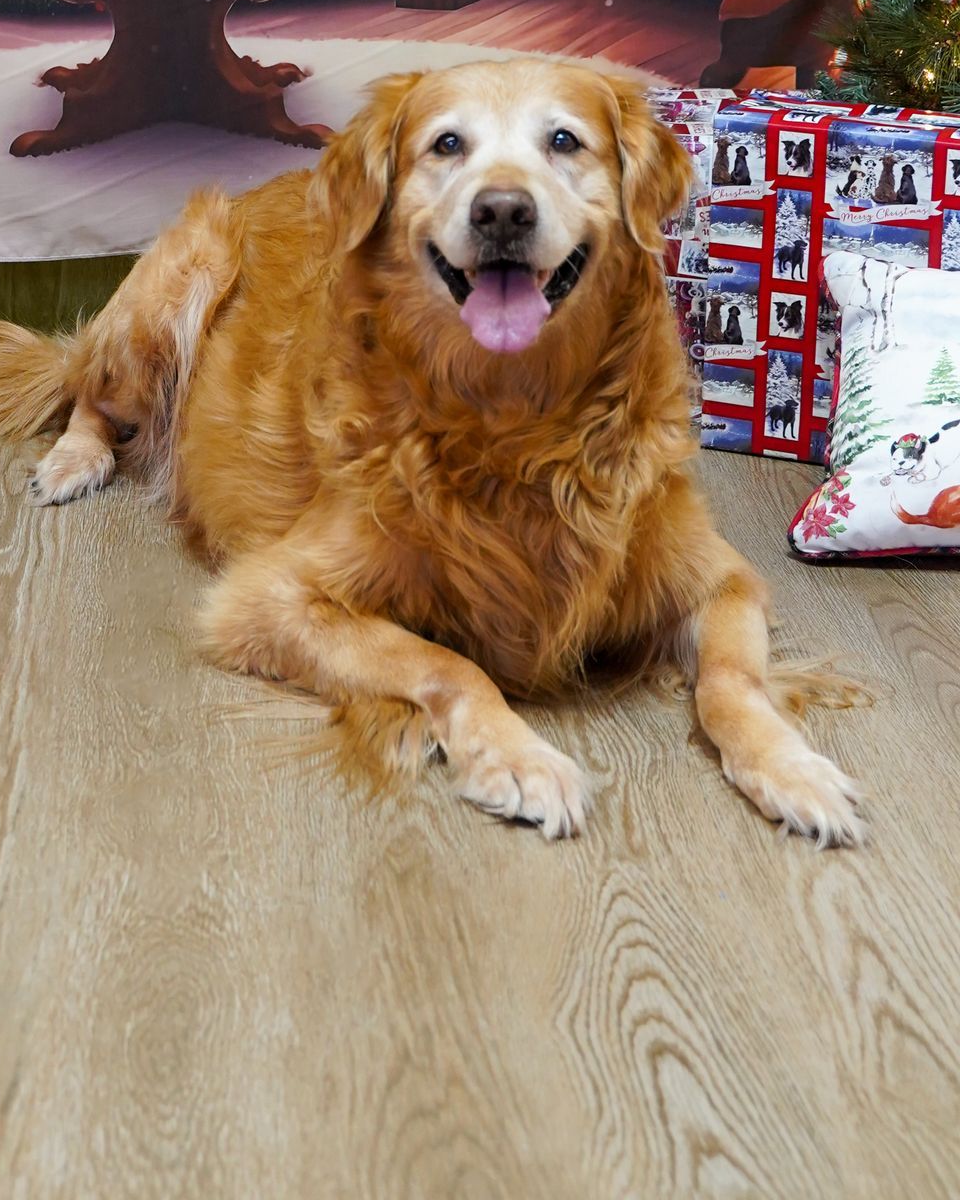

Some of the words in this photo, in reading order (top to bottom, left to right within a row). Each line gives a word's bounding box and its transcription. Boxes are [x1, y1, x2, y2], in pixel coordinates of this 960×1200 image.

[712, 187, 763, 201] Christmas
[840, 211, 874, 224] Merry
[876, 207, 929, 220] Christmas
[704, 346, 753, 359] Christmas
